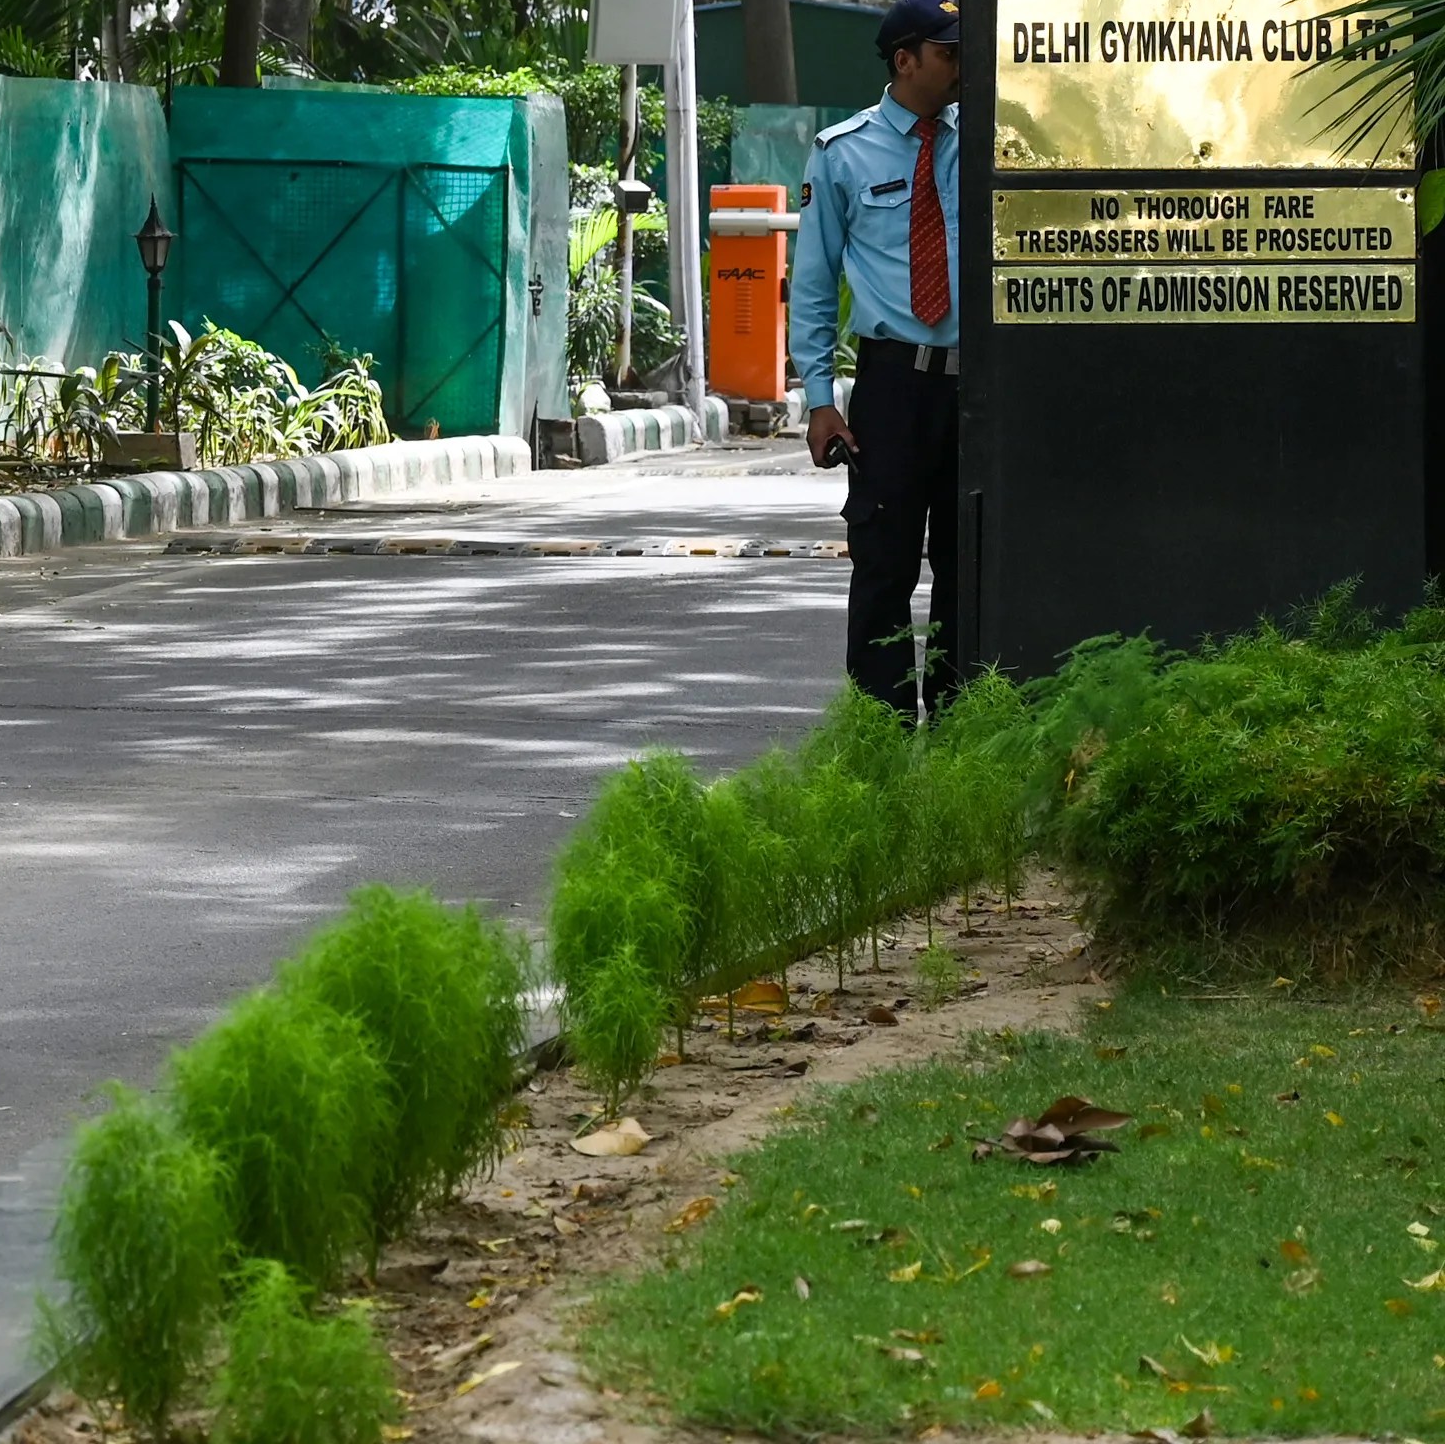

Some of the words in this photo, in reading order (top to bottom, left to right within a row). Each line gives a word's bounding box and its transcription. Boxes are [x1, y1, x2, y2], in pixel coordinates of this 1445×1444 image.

[1013, 21, 1090, 63] DELHI
[1101, 20, 1253, 63] GYMKHANA
[1262, 19, 1333, 62] CLUB
[1091, 196, 1120, 221] NO
[1134, 196, 1250, 220] THOROUGH
[1264, 195, 1315, 219] FARE
[1016, 229, 1159, 254] TRESPASSERS
[1166, 229, 1216, 253] WILL
[1222, 228, 1248, 253] BE
[1256, 227, 1392, 252] PROSECUTED
[718, 268, 765, 281] FAAC
[1007, 276, 1093, 314] RIGHTS
[1102, 276, 1131, 313] OF
[1137, 276, 1270, 313] ADMISSION
[1278, 274, 1403, 312] RESERVED
